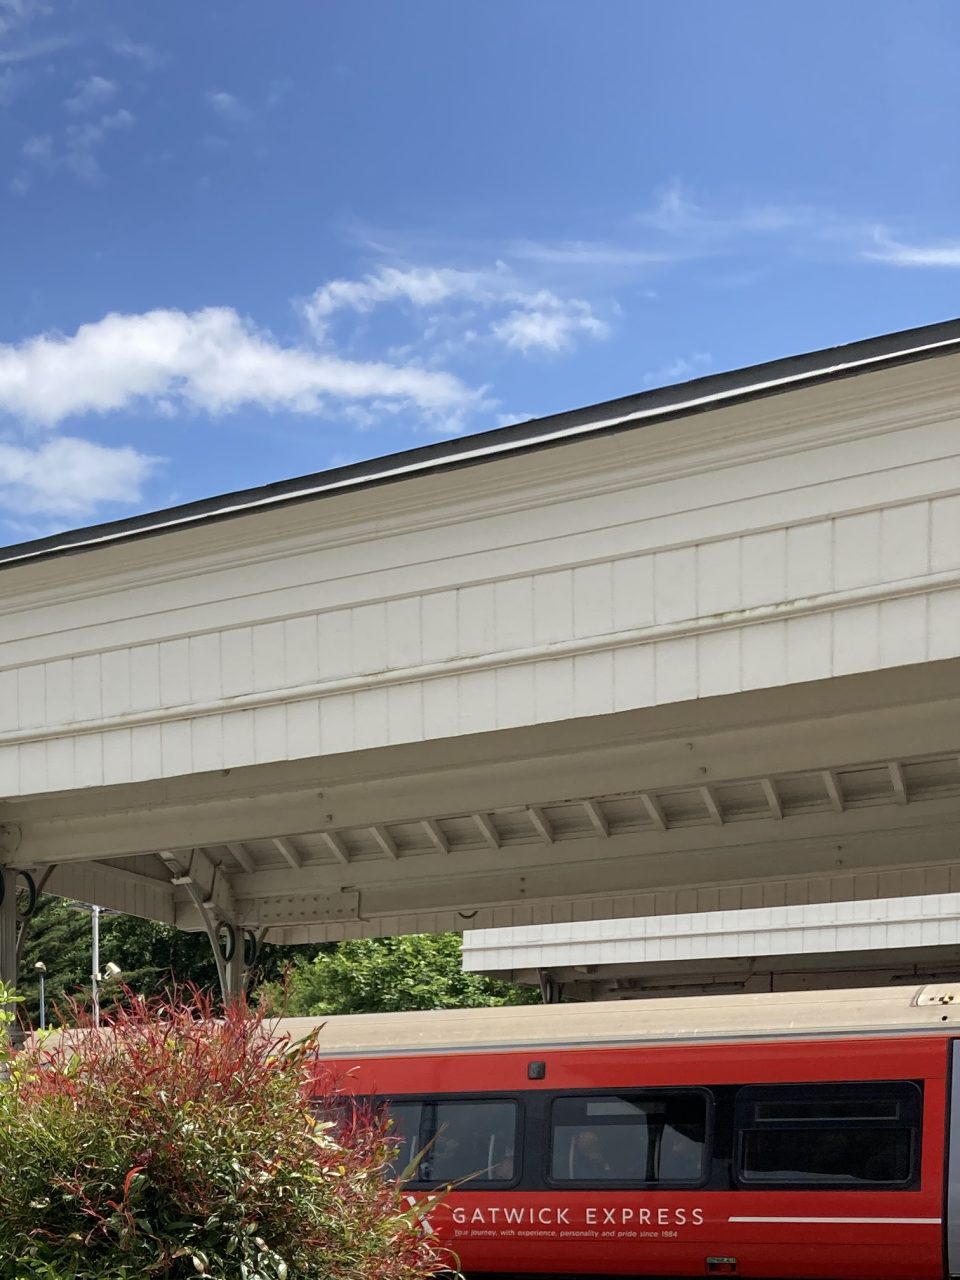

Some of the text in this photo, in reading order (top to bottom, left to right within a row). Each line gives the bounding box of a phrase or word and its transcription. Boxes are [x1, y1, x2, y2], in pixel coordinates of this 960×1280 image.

[452, 1207, 570, 1225] GATWICK
[585, 1207, 704, 1226] EXPRESS
[454, 1229, 469, 1237] Your
[500, 1229, 515, 1237] with
[559, 1230, 599, 1239] personality
[617, 1230, 637, 1239] pride
[639, 1230, 658, 1238] since
[661, 1230, 678, 1238] 1984
